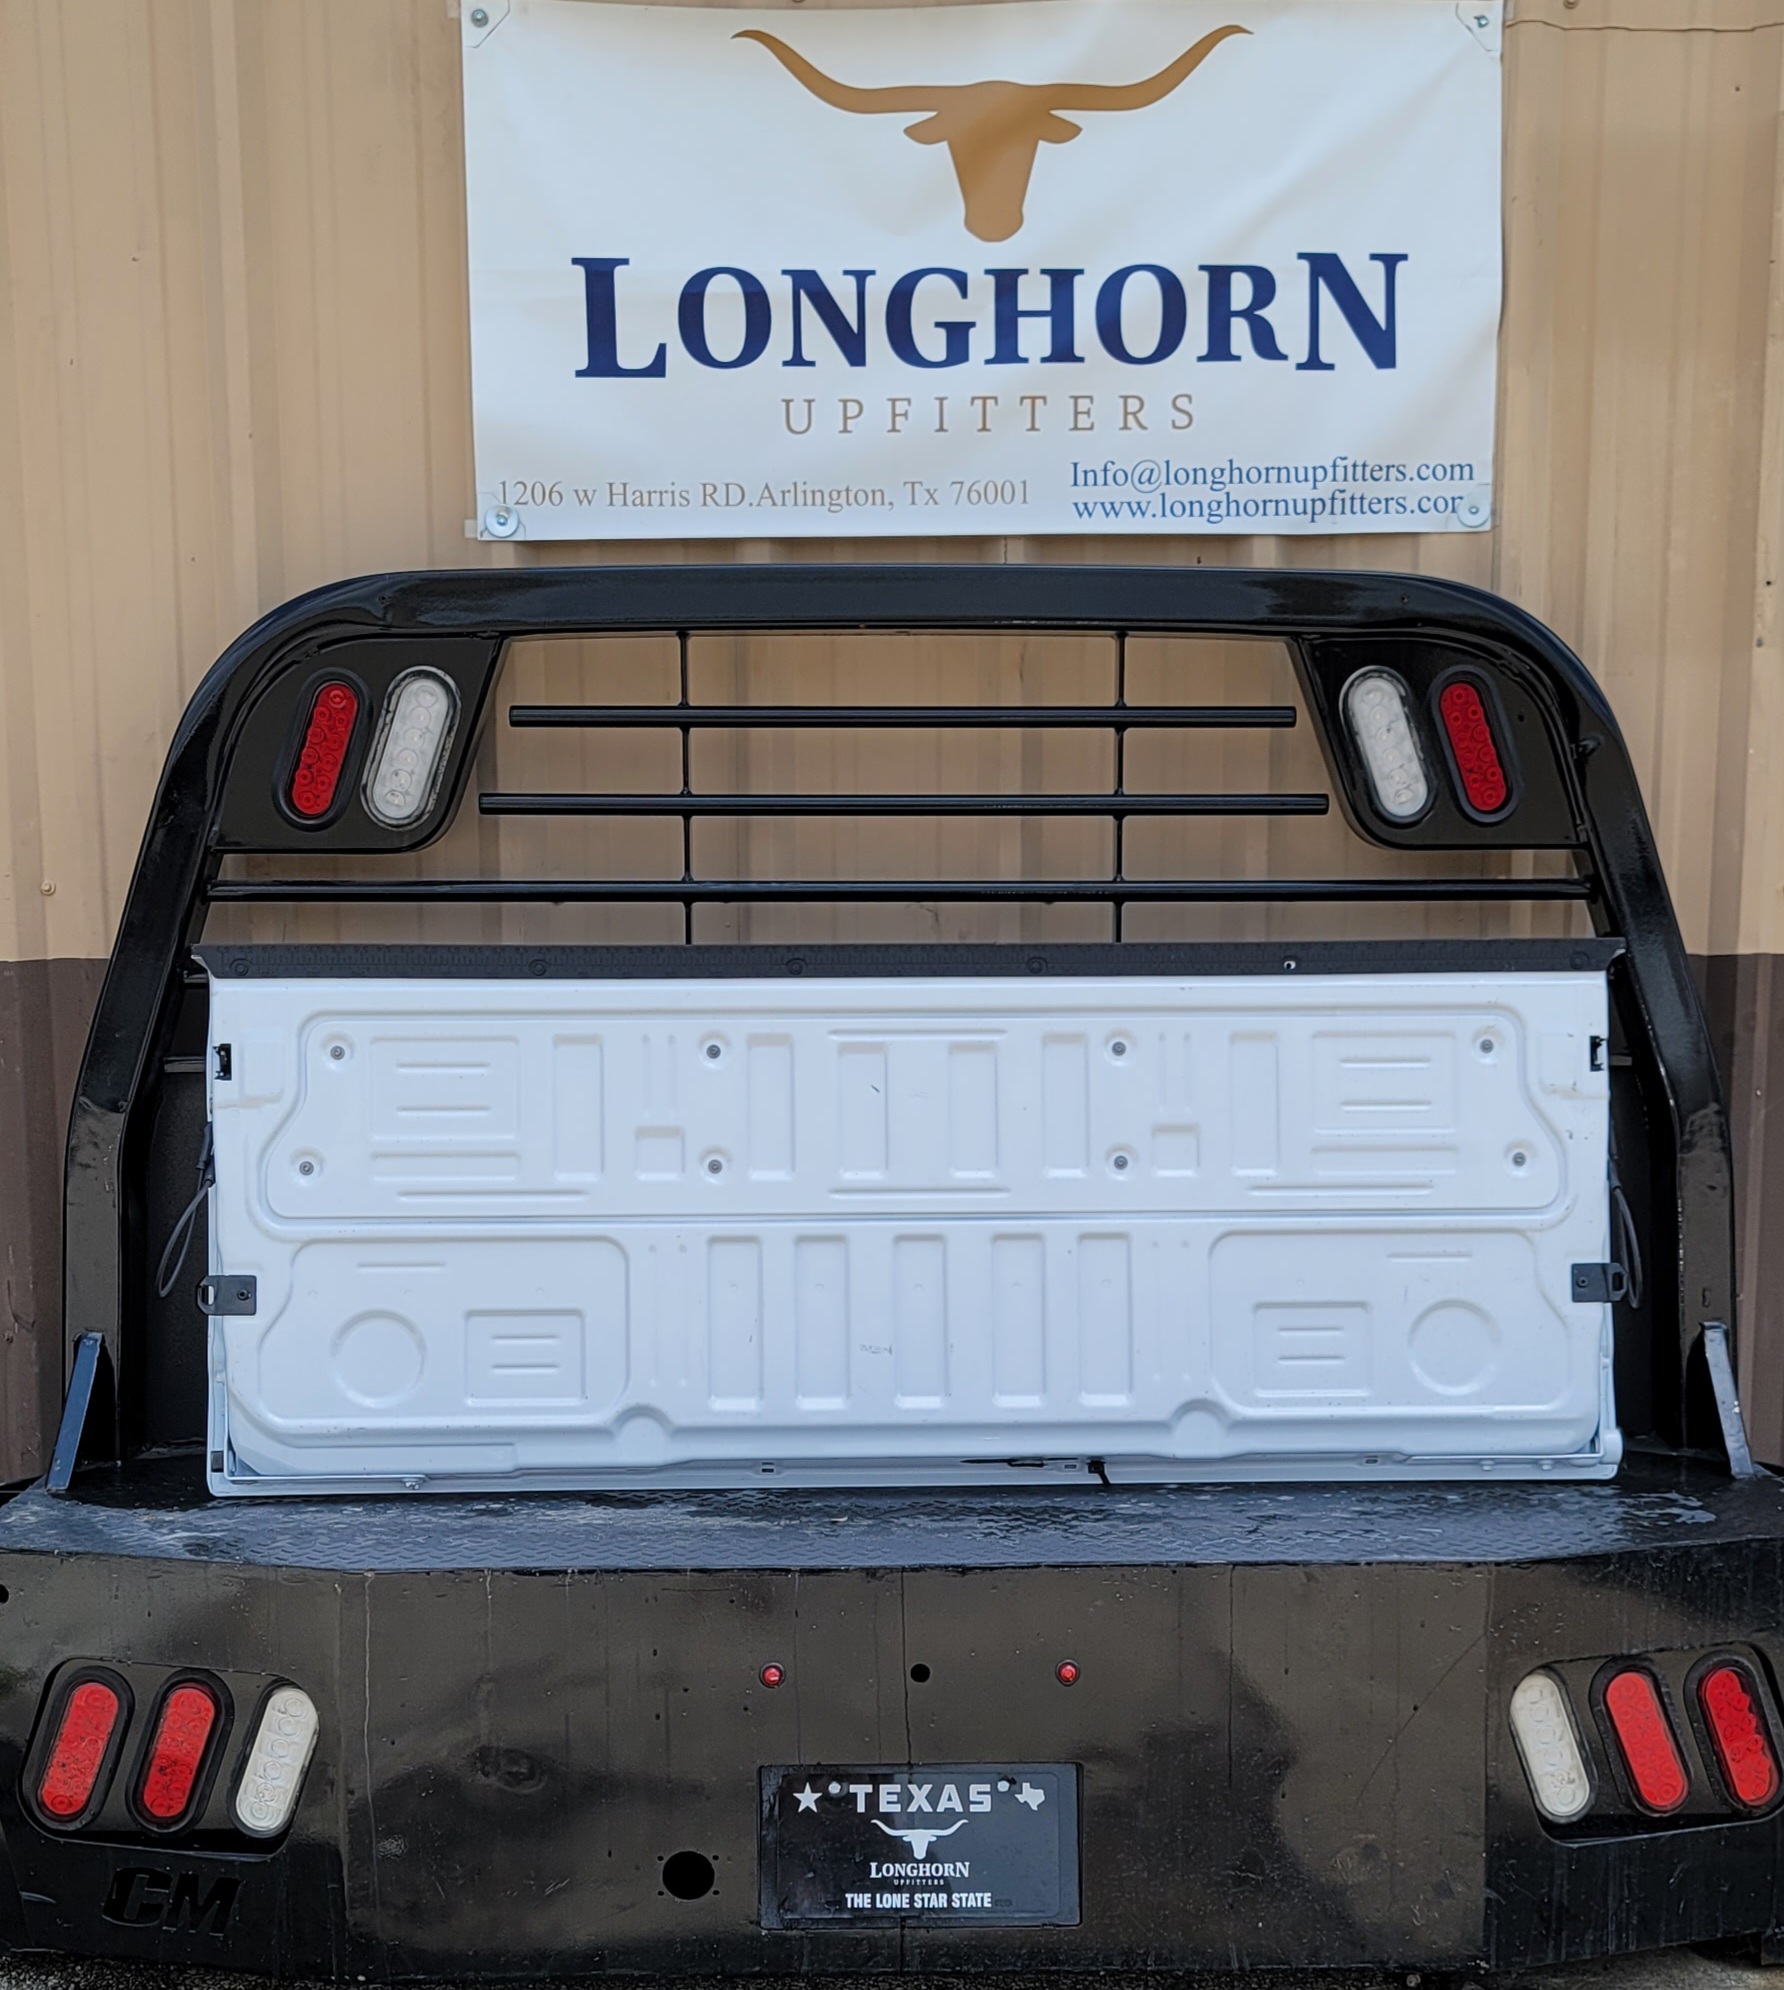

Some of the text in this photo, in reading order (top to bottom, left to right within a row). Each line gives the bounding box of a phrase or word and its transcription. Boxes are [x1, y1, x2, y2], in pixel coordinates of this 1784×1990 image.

[571, 252, 1408, 378] LONGHORN
[781, 394, 1194, 435] UPFITTERS
[1070, 456, 1475, 493] Info@longhornupfitters.com
[498, 480, 564, 506] 1206
[573, 487, 597, 507] w
[606, 482, 690, 507] Harris
[903, 481, 940, 506] Tx
[949, 479, 1029, 505] 76001
[849, 1783, 992, 1813] TEXAS
[869, 1862, 970, 1878] LONGHORN
[102, 1866, 244, 1936] CM
[845, 1892, 992, 1909] THE LONE STAR STATE
